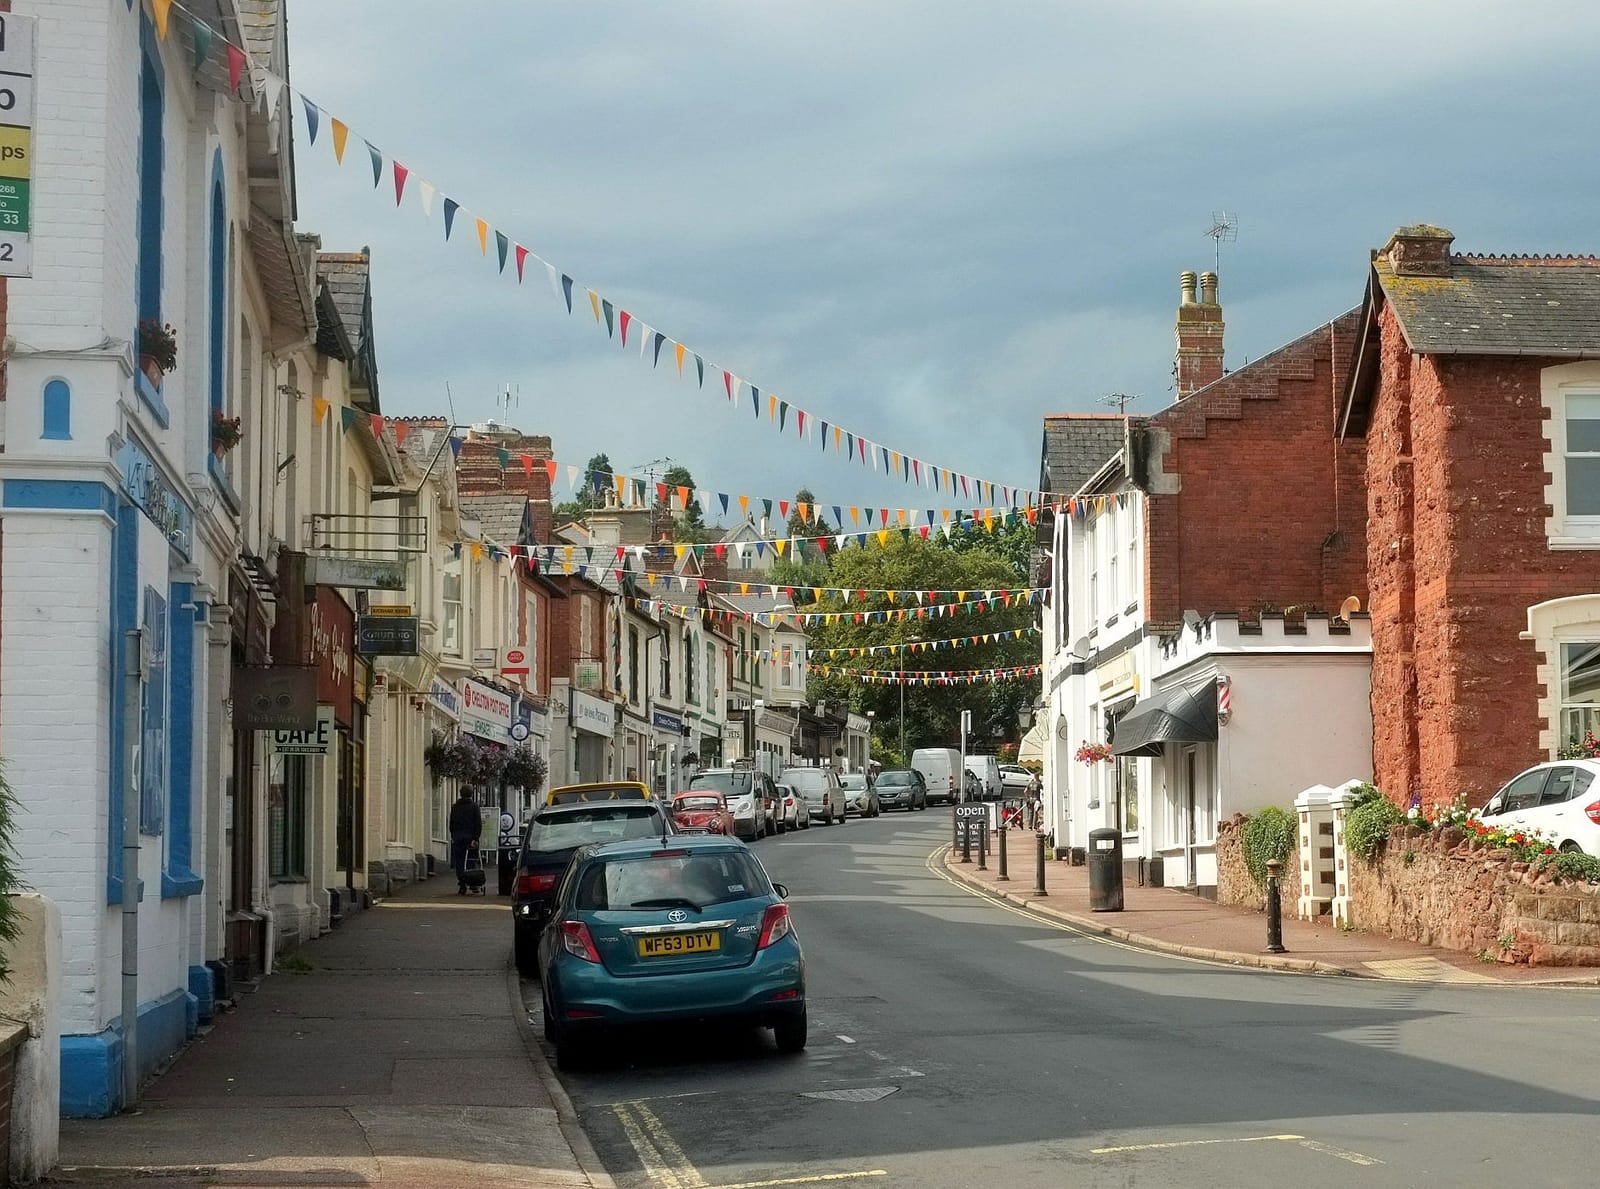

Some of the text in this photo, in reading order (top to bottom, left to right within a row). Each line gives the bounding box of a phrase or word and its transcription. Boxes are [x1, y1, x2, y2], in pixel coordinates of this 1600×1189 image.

[1, 145, 25, 160] ps
[3, 213, 19, 225] 33
[0, 243, 13, 262] 2
[956, 807, 985, 818] open
[645, 933, 713, 952] WF63 DTV
